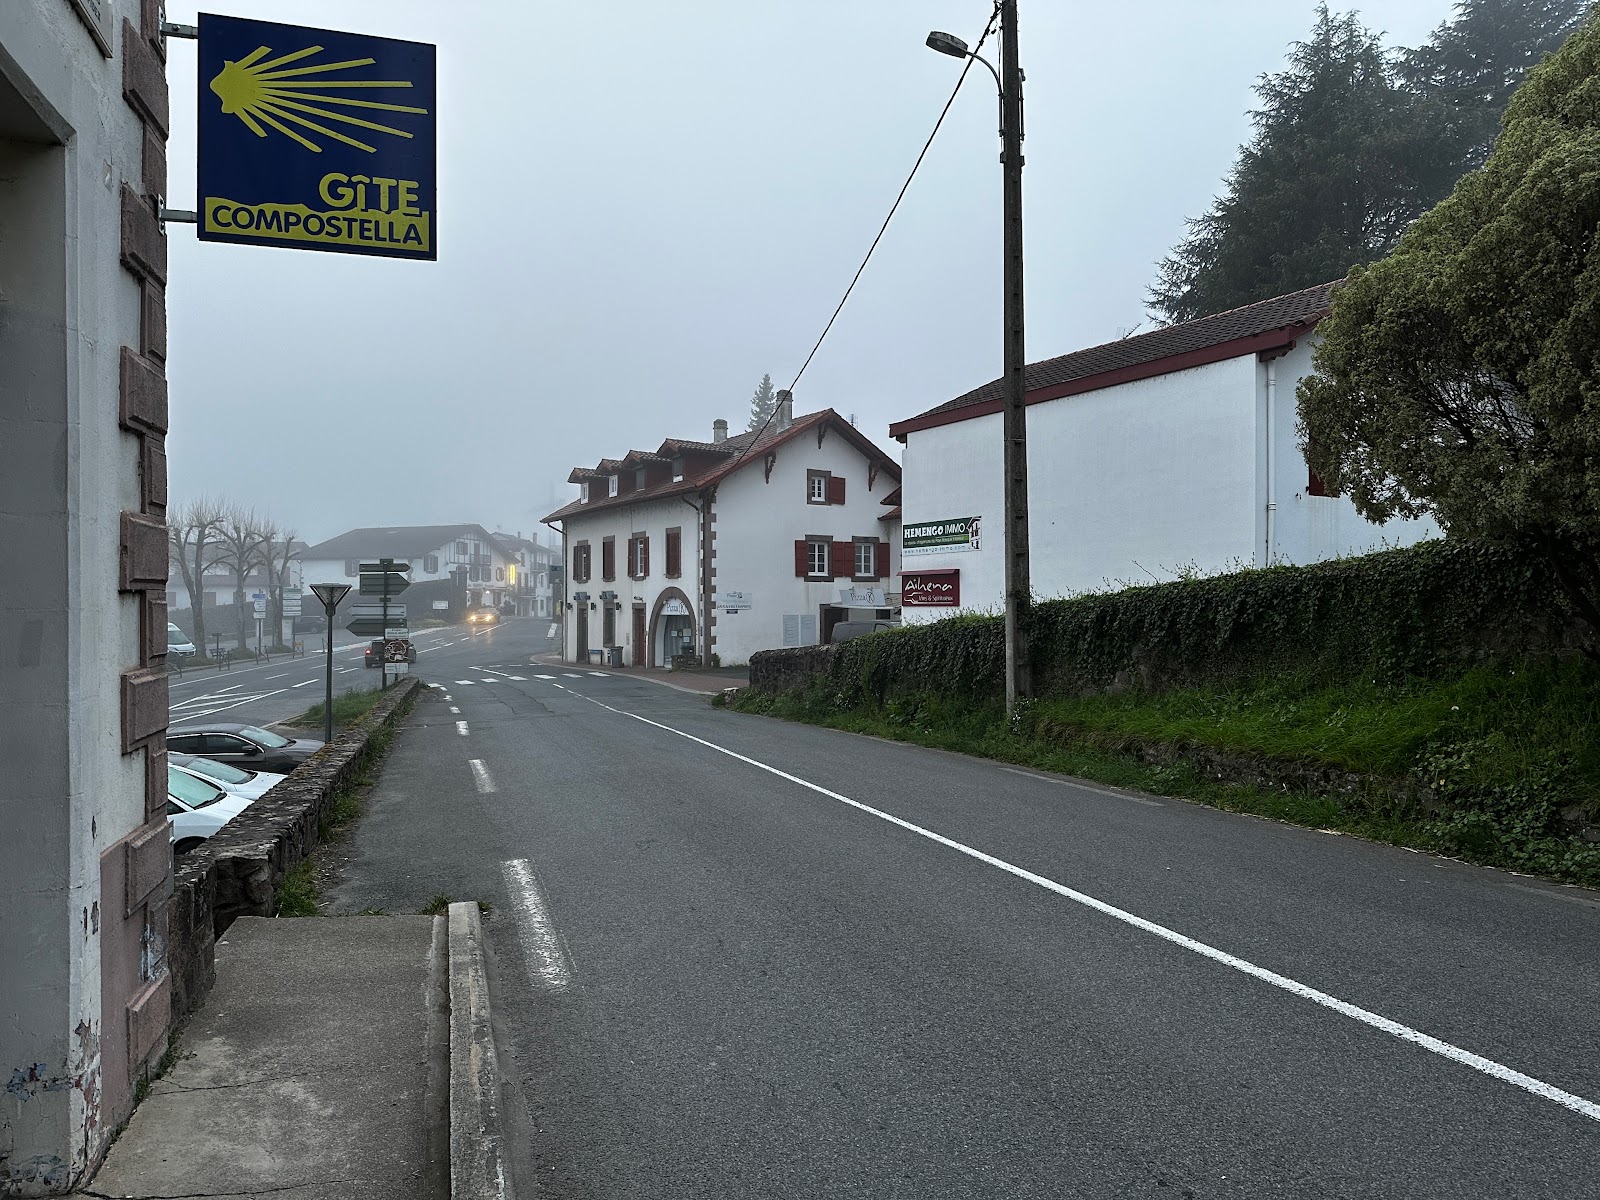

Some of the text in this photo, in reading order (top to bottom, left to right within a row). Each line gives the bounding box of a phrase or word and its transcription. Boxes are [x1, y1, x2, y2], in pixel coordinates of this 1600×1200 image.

[212, 205, 423, 246] COMPOSTELLA
[904, 522, 966, 539] HEMENGO IMMO
[904, 577, 953, 592] Aihena
